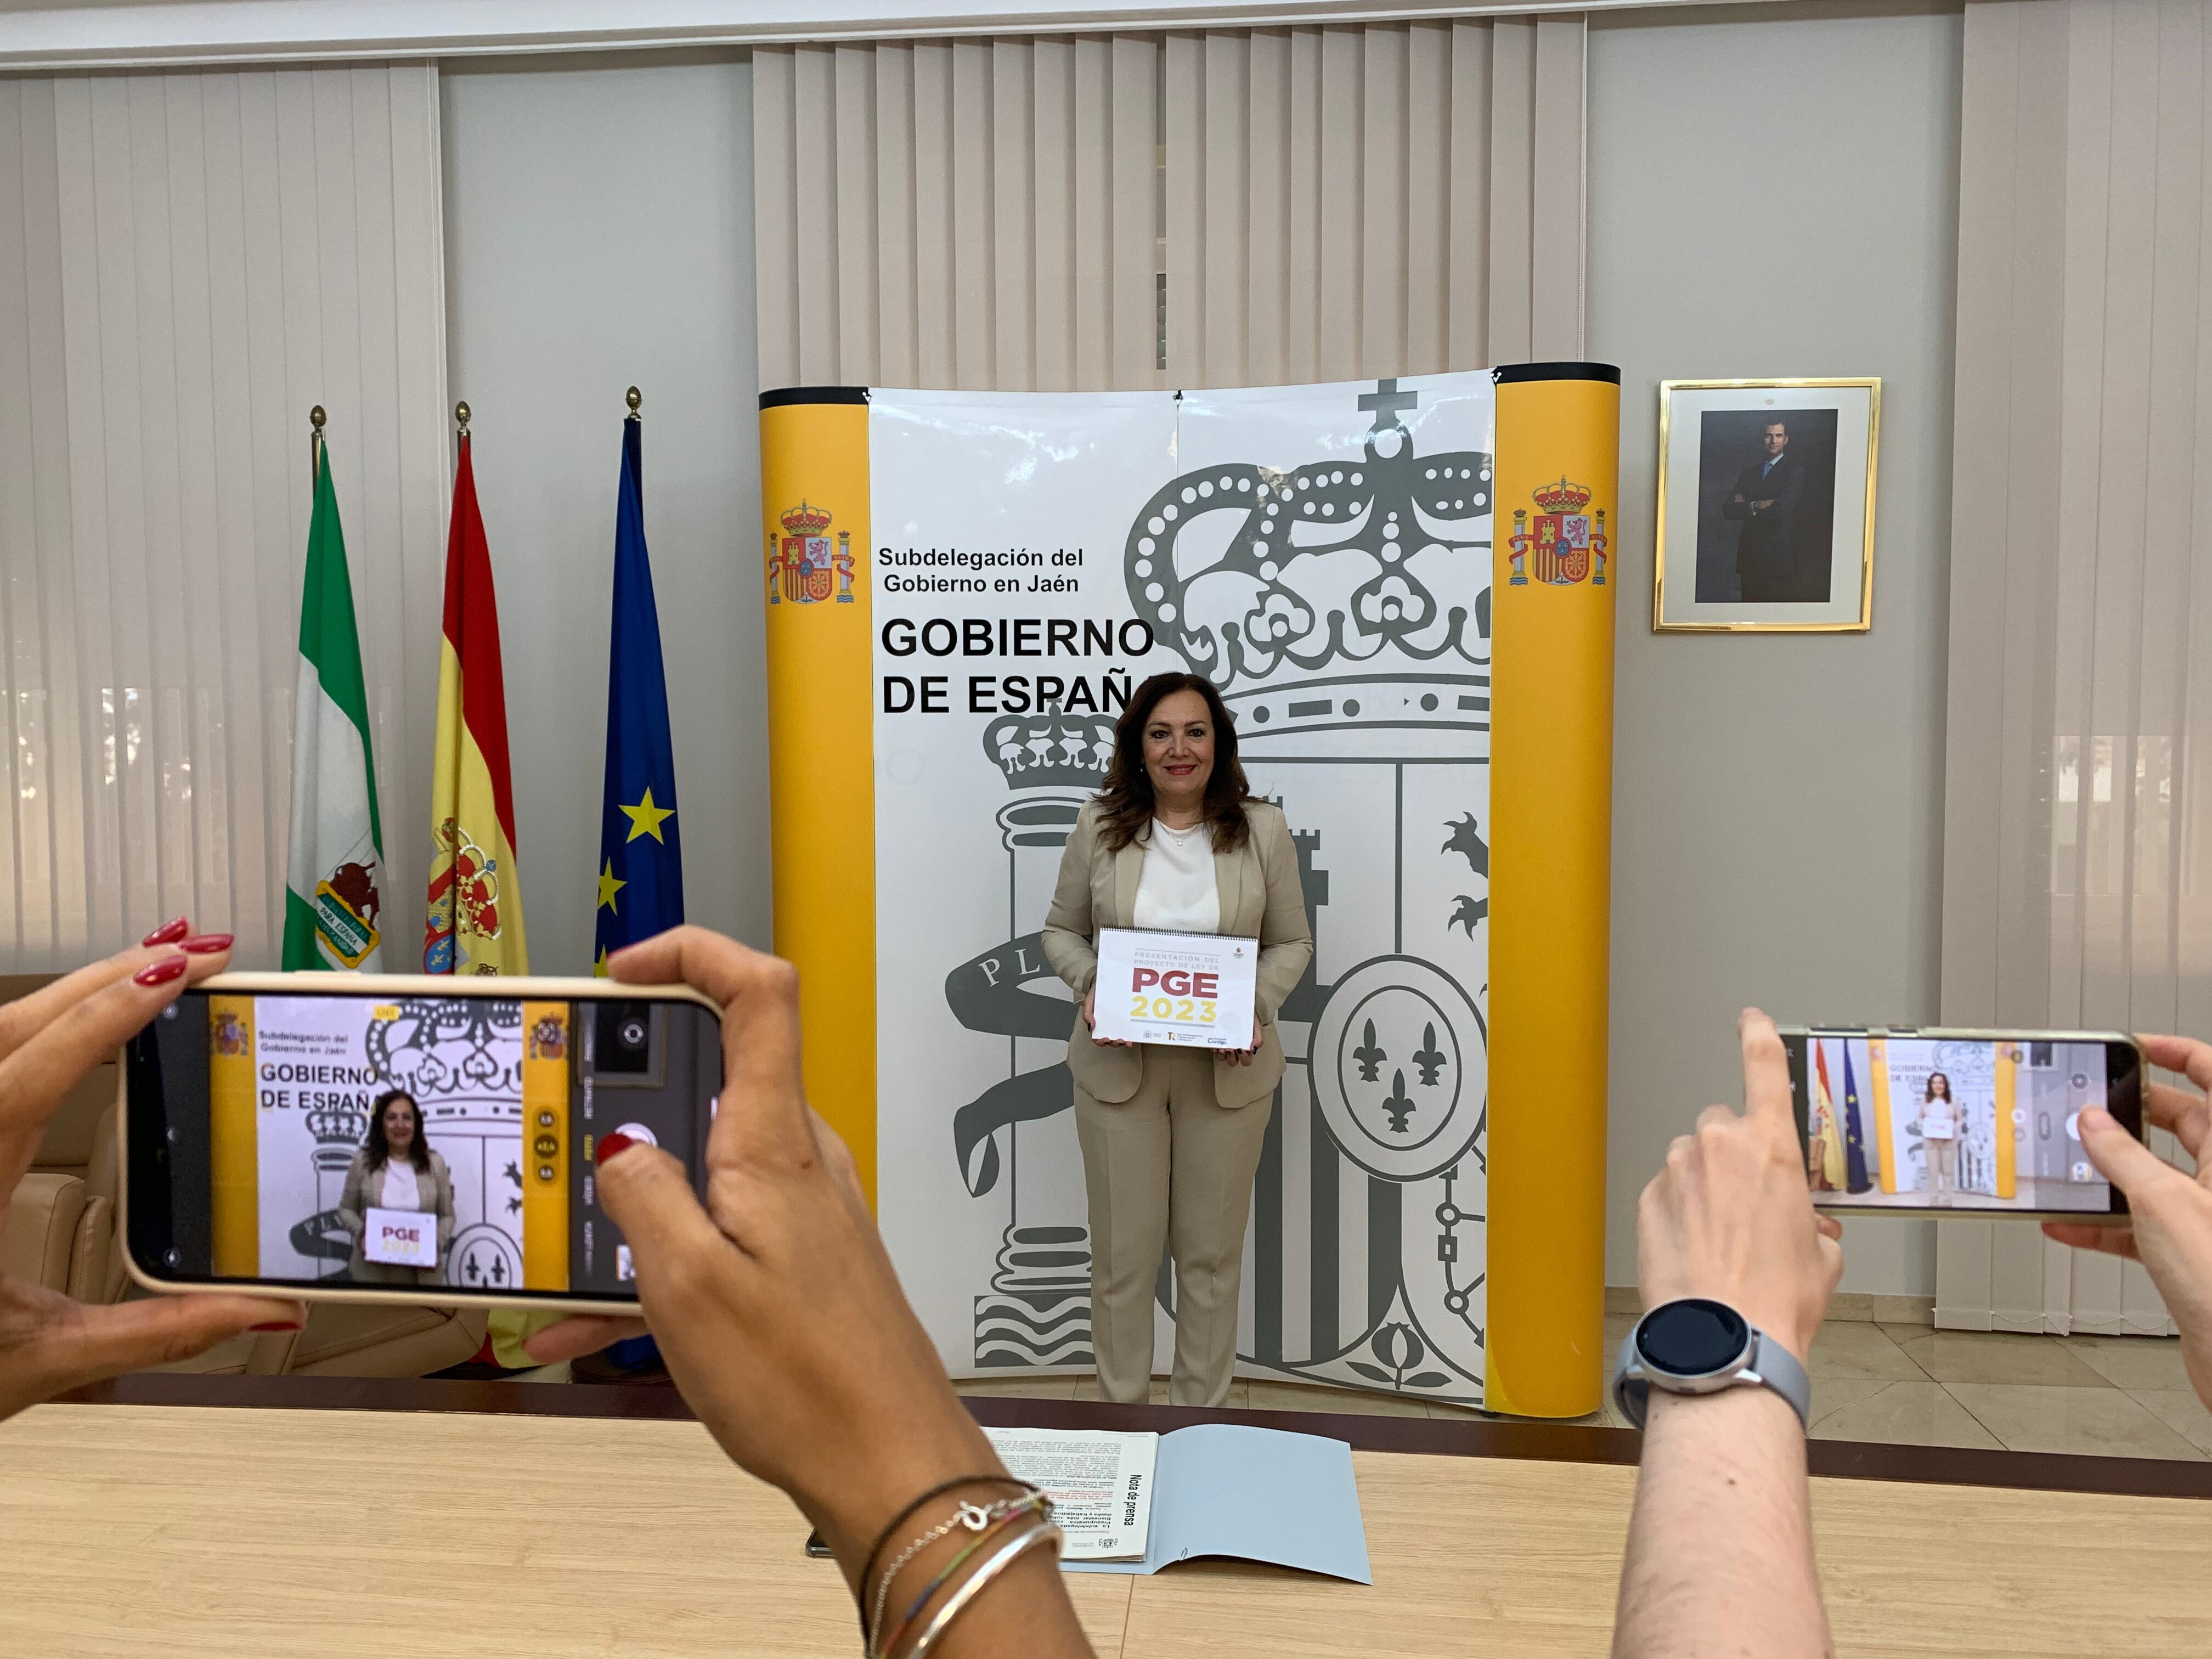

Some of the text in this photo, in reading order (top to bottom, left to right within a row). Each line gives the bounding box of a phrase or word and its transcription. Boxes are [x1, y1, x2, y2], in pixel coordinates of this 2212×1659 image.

[878, 548, 1084, 570] Subdelegación del
[884, 574, 1079, 592] Gobierno en Jaén
[882, 618, 1154, 657] GOBIERNO
[883, 667, 1132, 713] DE ESPAÑ
[978, 949, 1040, 987] PL
[1135, 952, 1200, 962] PRESENTACIÓN
[1132, 967, 1219, 998] PGE
[1130, 996, 1217, 1023] 2023
[261, 1063, 377, 1085] GOBIERNO
[261, 1089, 370, 1110] DE ESPAÑ
[382, 1227, 419, 1243] PGE
[1124, 1475, 1142, 1526] Nota de prensa
